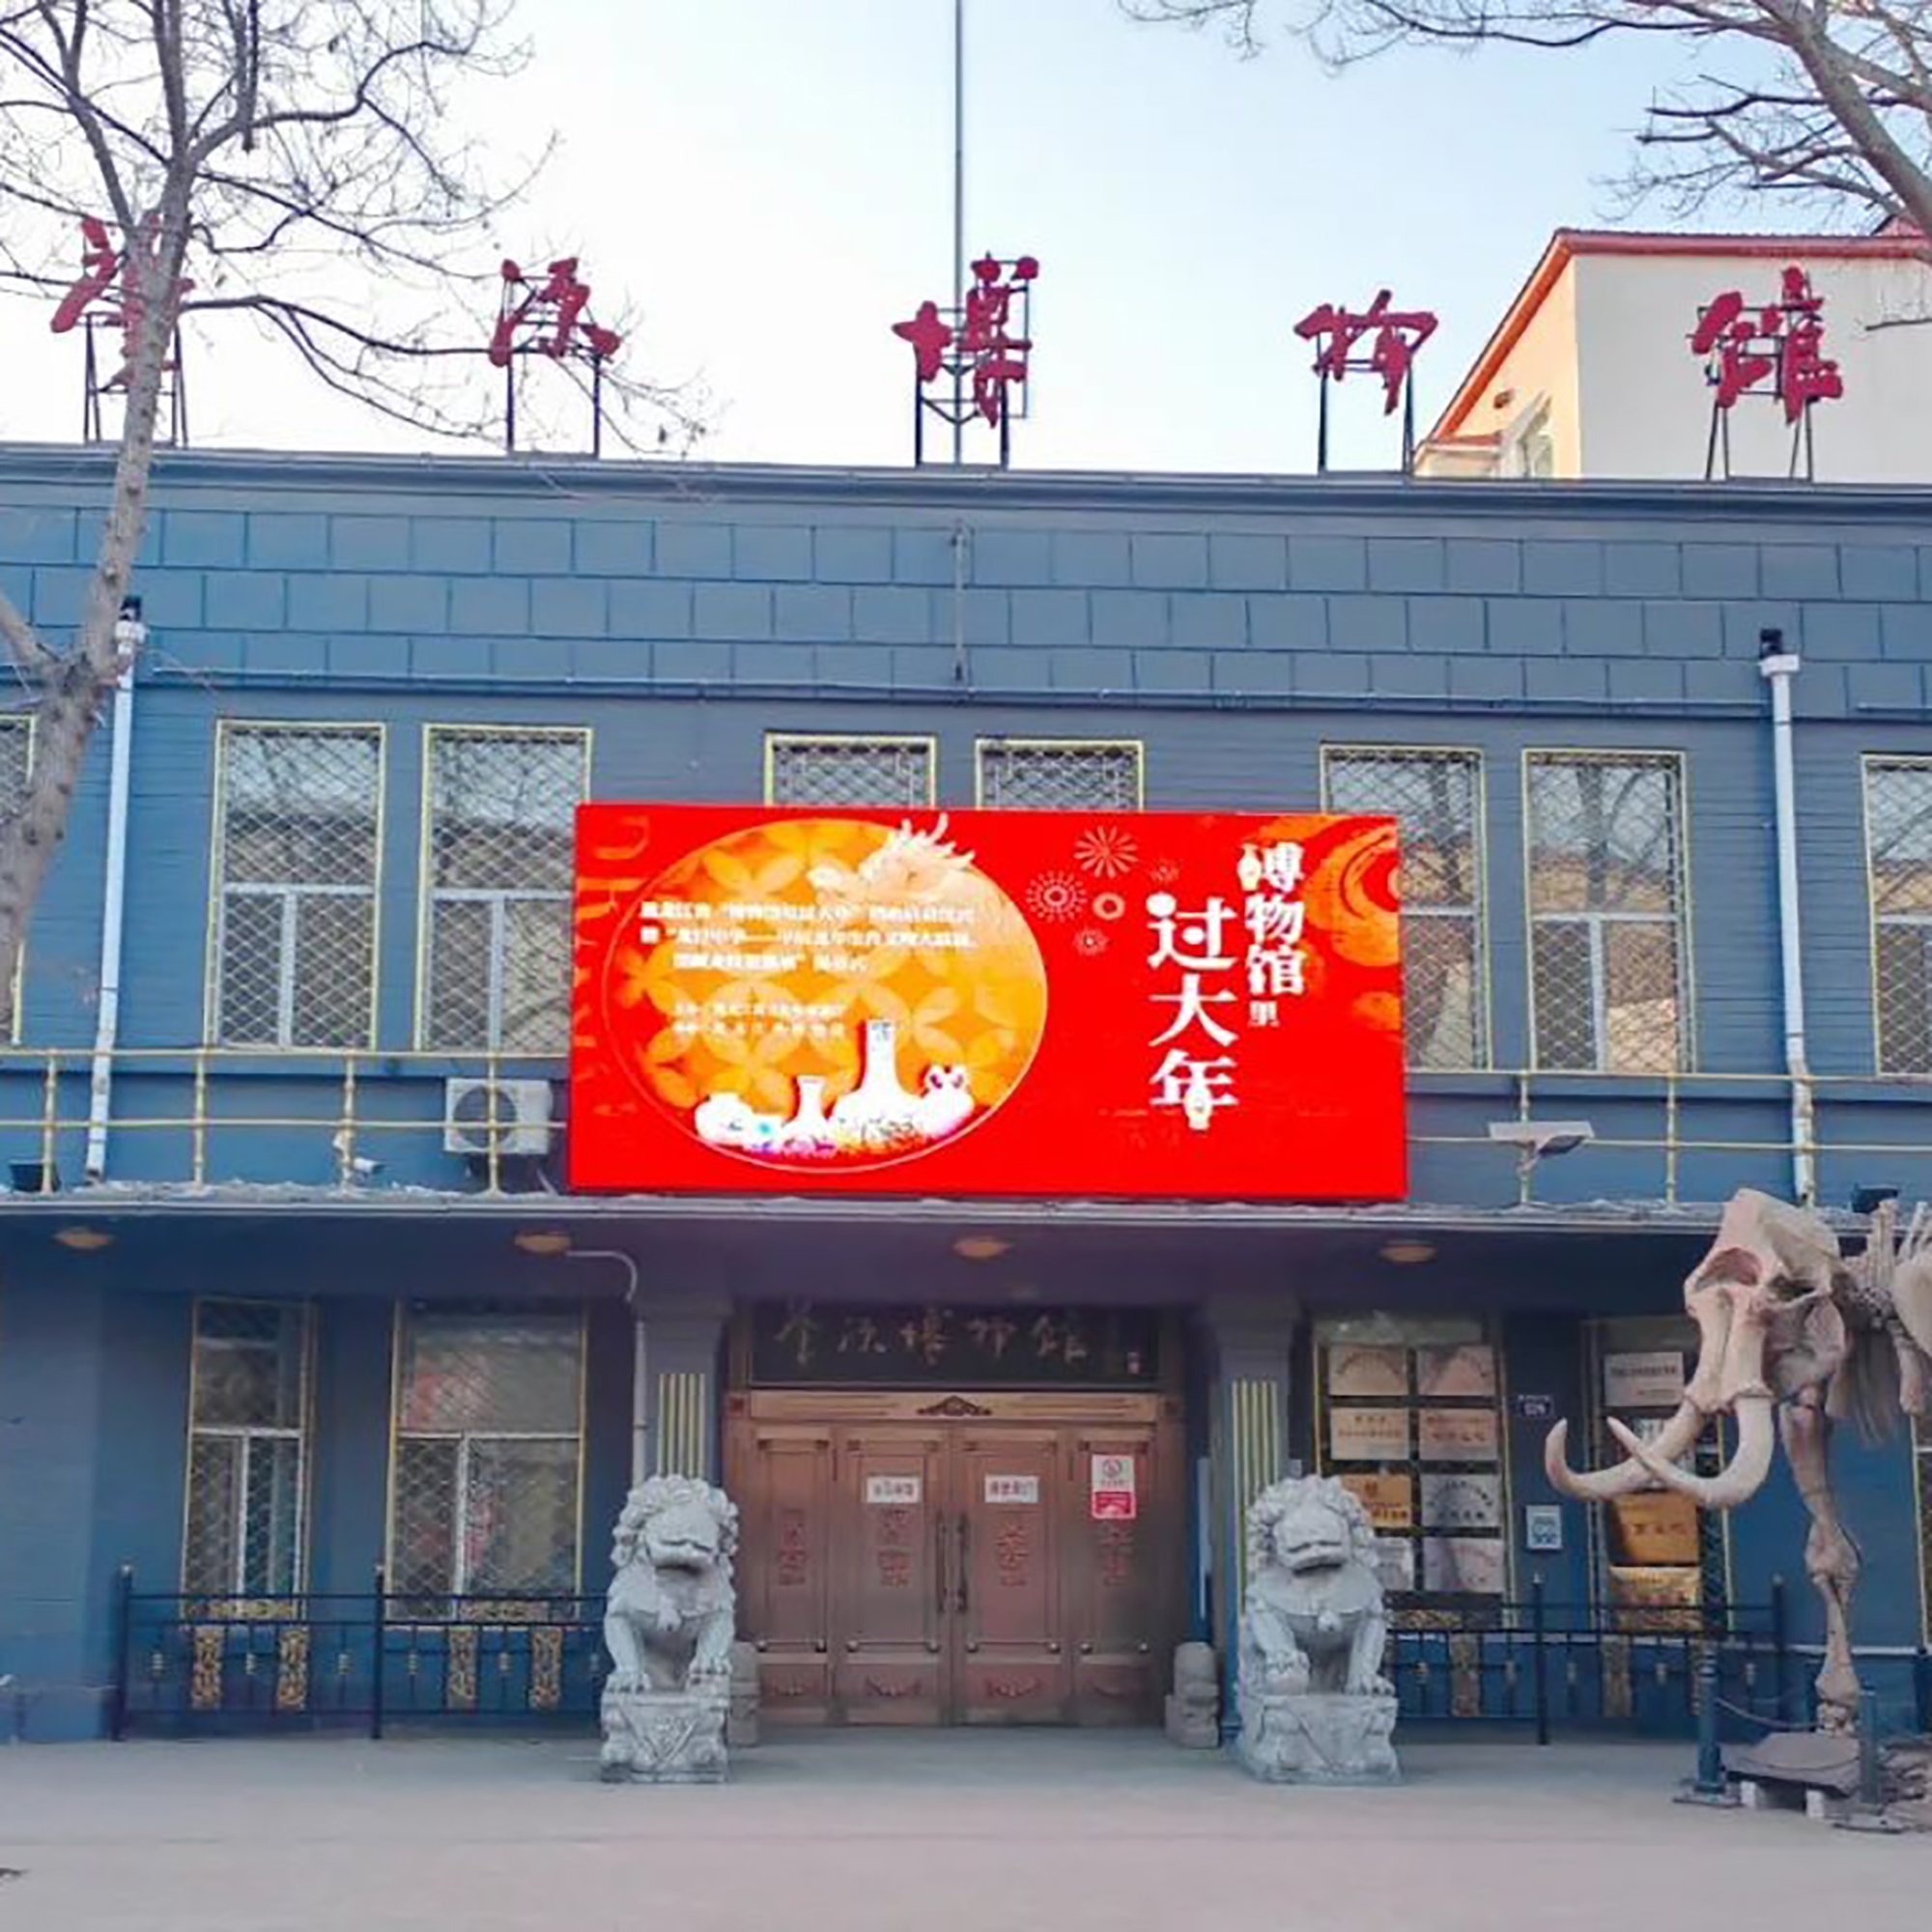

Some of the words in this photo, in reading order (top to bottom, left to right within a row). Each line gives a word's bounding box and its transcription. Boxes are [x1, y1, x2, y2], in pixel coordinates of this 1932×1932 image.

[1146, 892, 1240, 1131] 过大年
[1237, 841, 1306, 1028] 博物馆里
